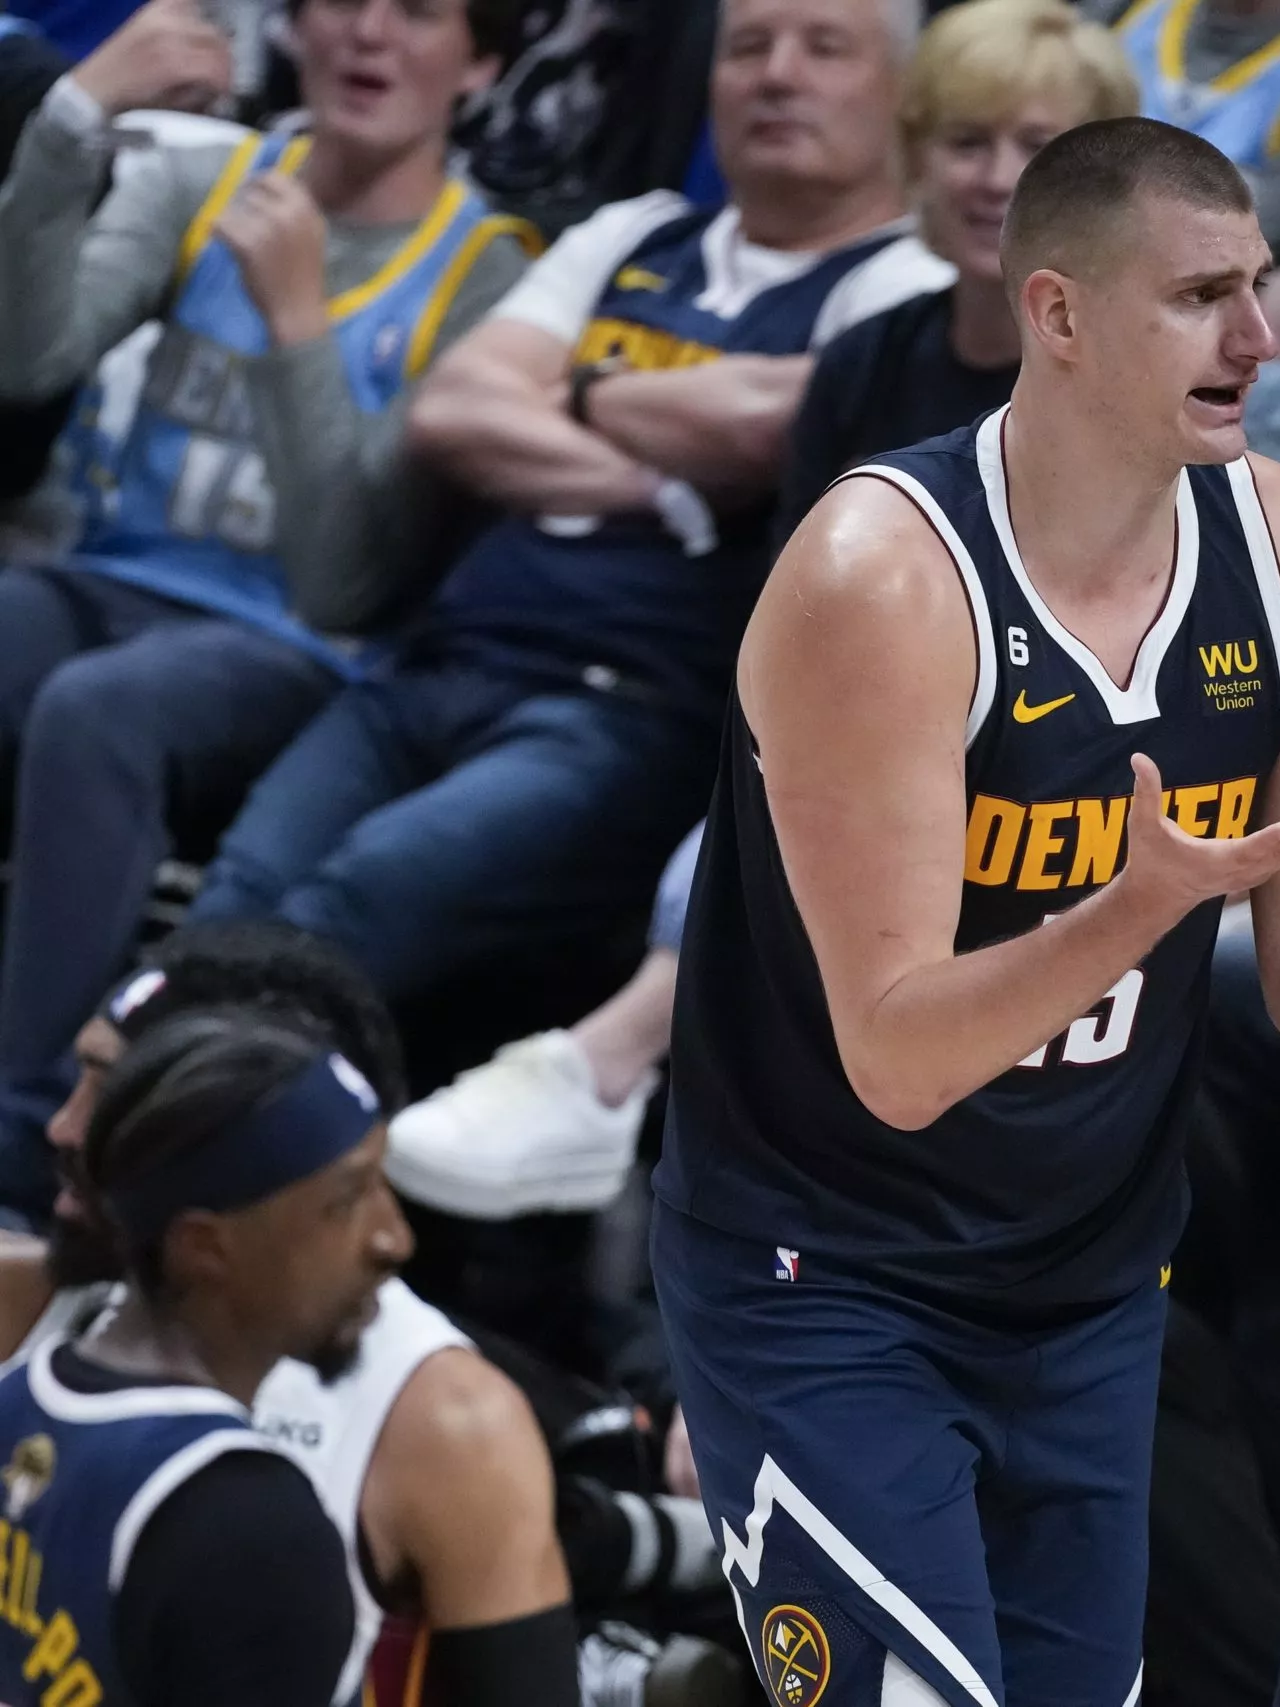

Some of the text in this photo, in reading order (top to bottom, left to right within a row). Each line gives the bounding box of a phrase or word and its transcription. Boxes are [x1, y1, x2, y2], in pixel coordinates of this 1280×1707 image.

[1007, 625, 1030, 667] 6
[1199, 640, 1259, 678] WU
[1203, 680, 1262, 697] Western
[1215, 694, 1255, 711] Union
[965, 776, 1258, 890] DENER
[1016, 913, 1144, 1068] 5
[775, 1269, 789, 1280] NBA
